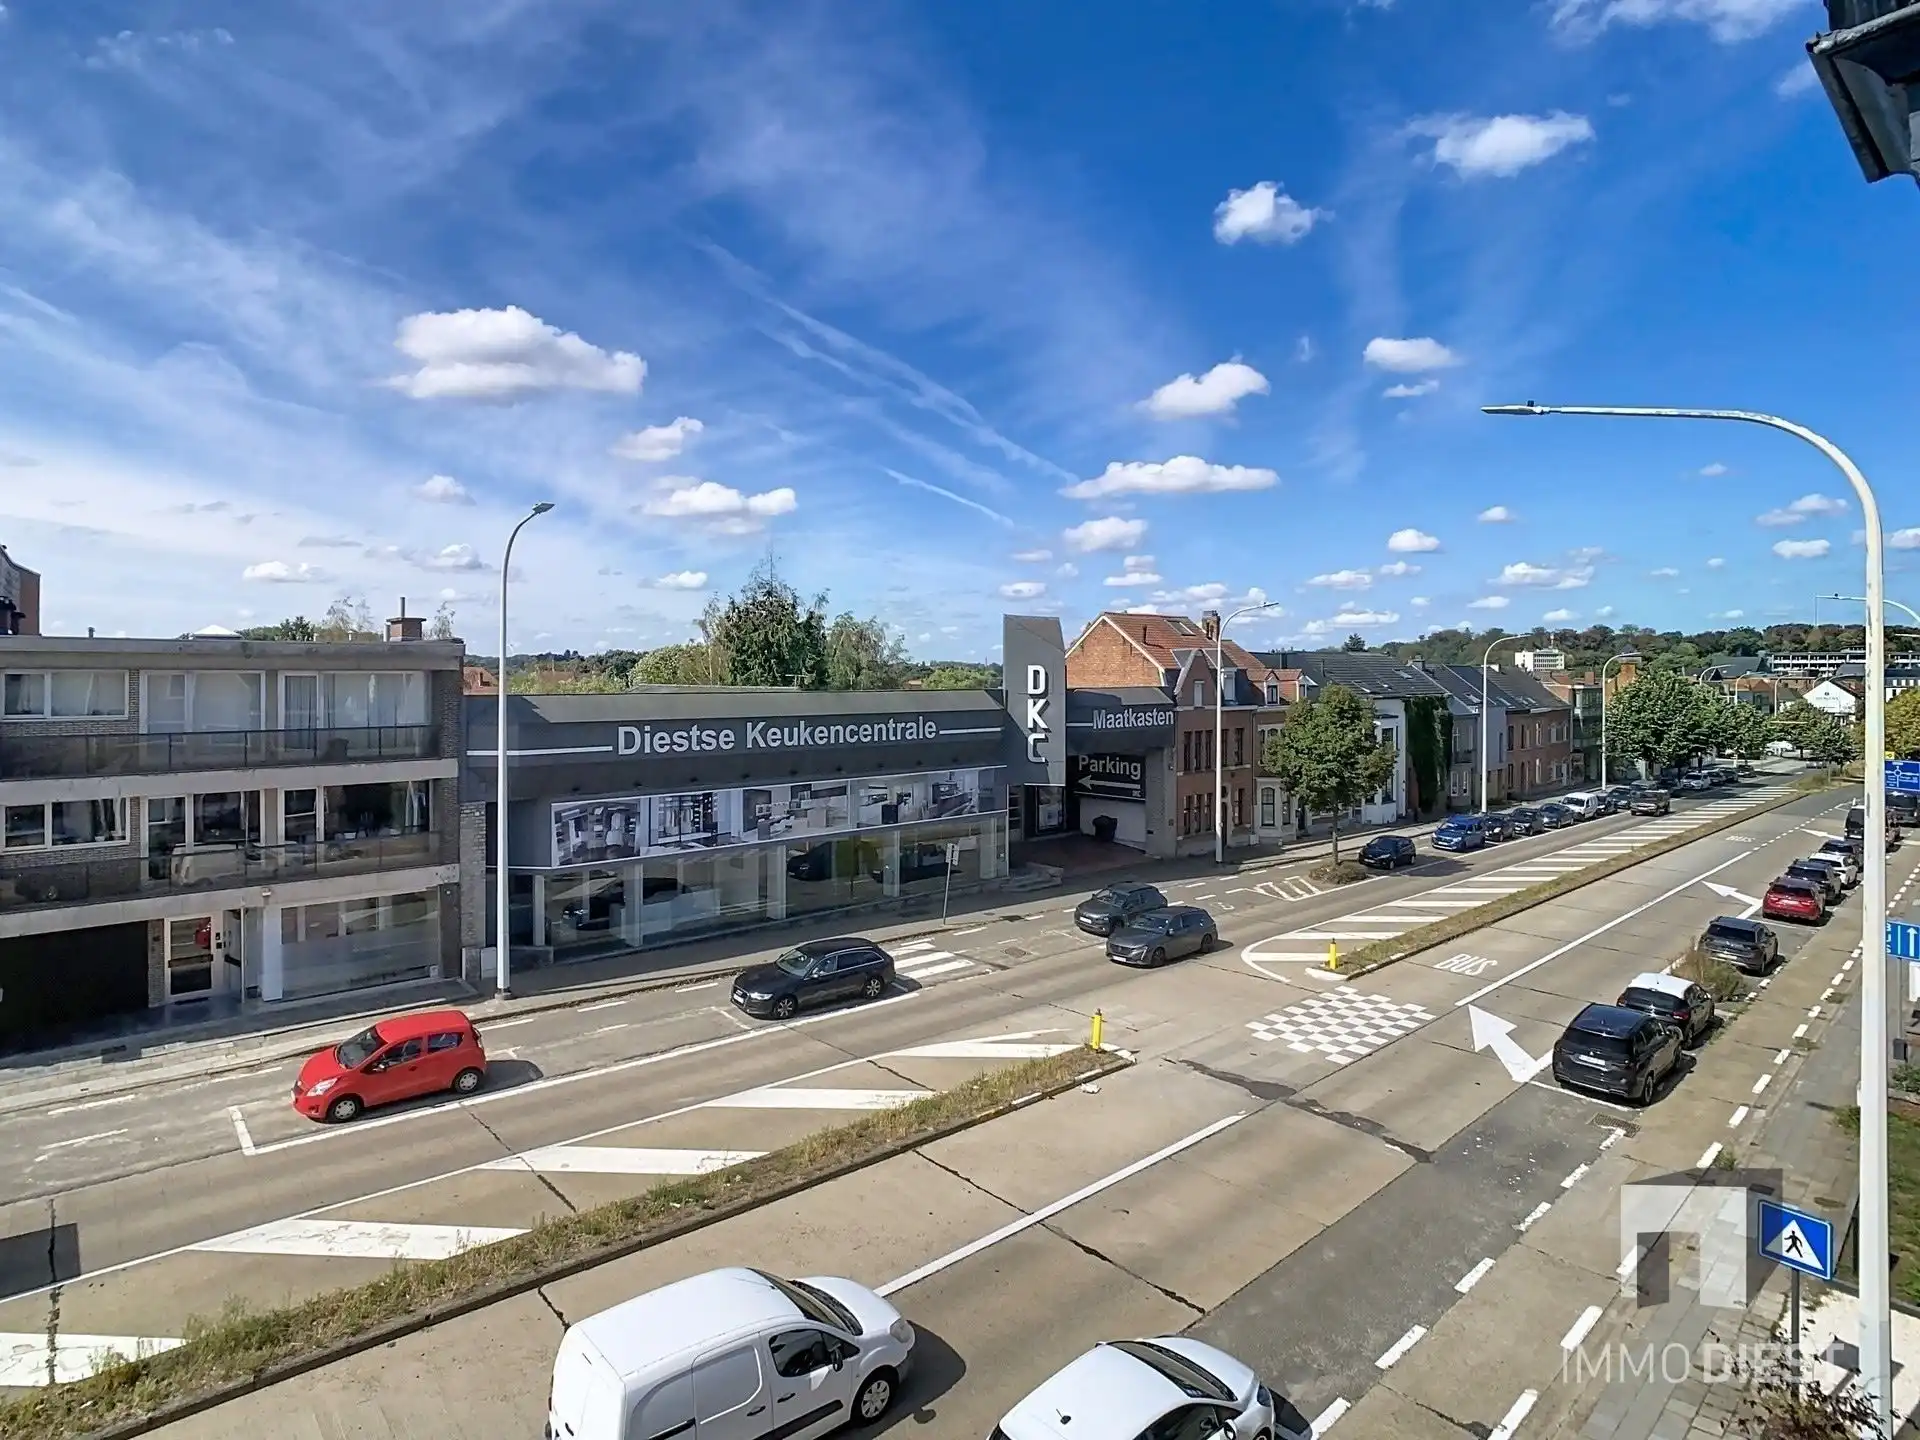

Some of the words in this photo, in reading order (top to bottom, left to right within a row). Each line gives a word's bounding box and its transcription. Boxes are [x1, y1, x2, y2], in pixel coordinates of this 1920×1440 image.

[1027, 664, 1048, 763] DKC
[1093, 707, 1174, 730] Maatkasten
[617, 724, 736, 755] Diestse
[746, 715, 937, 748] Keukencentrale
[1078, 754, 1141, 780] Parking
[1433, 953, 1498, 976] BUS
